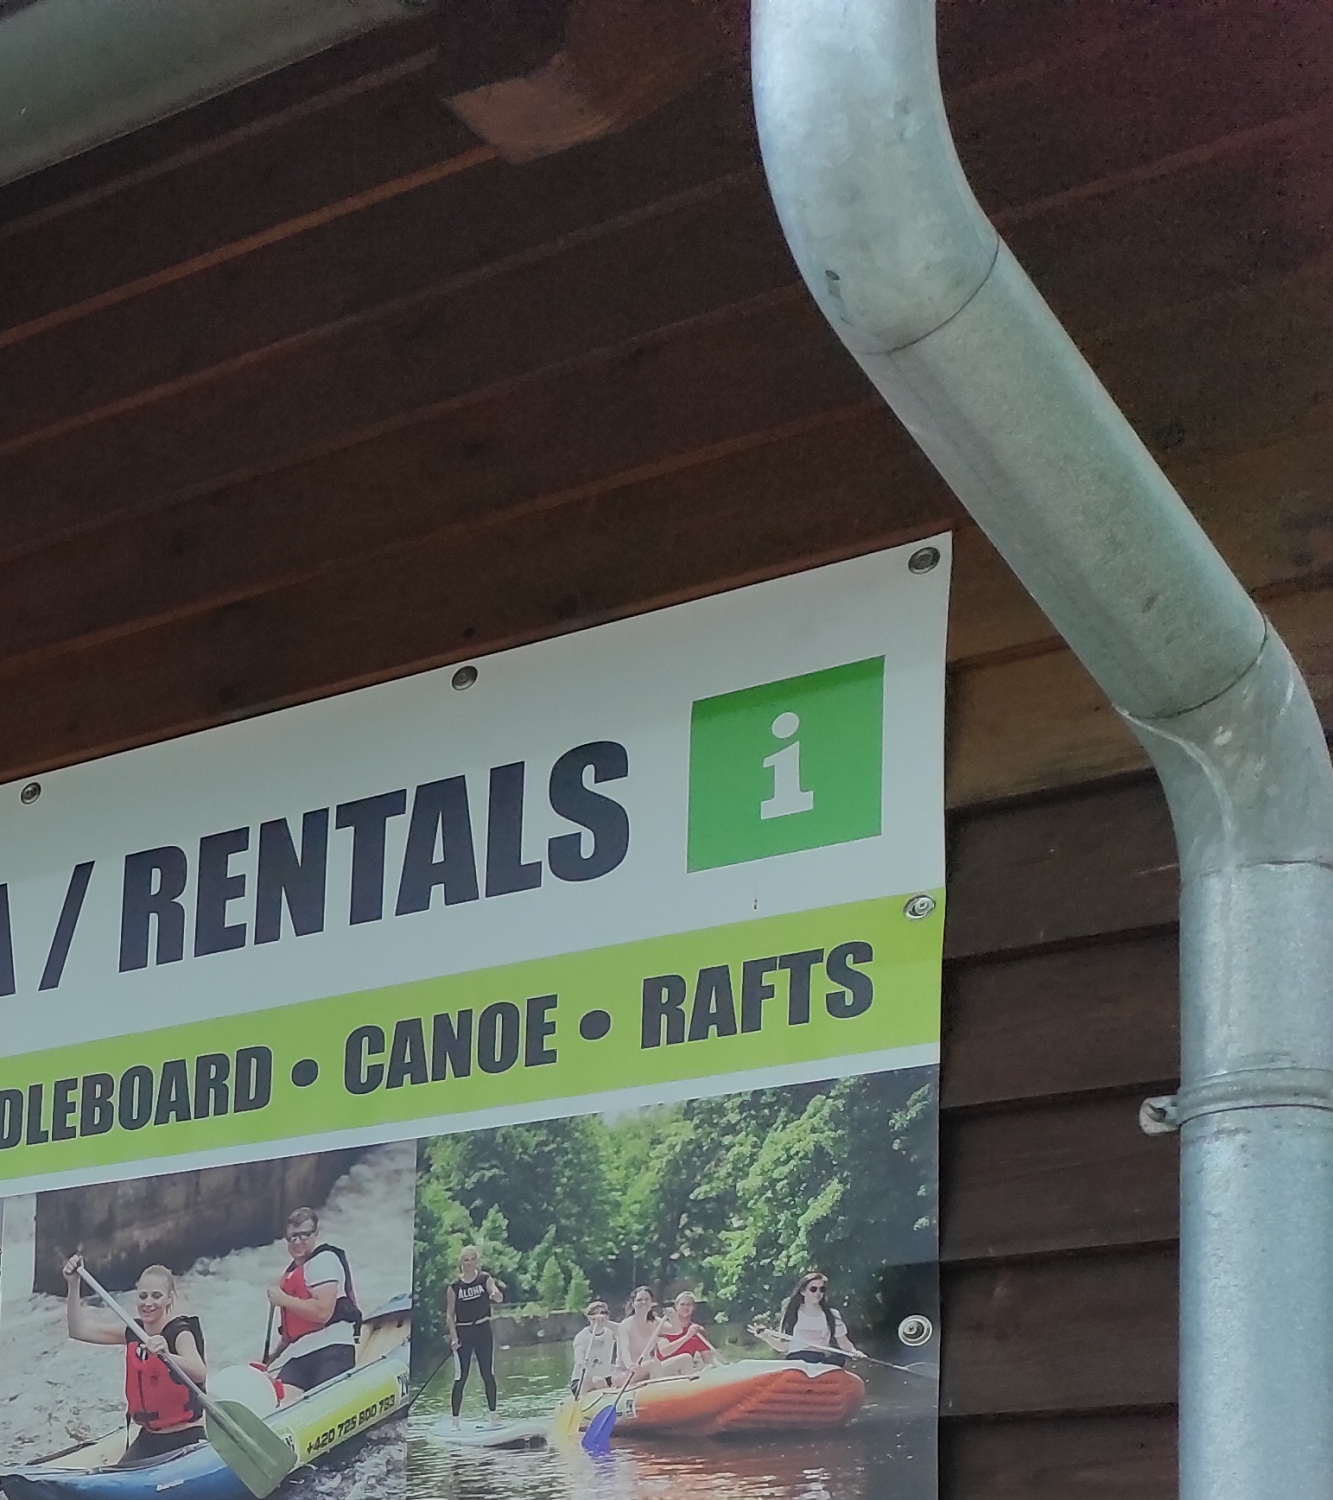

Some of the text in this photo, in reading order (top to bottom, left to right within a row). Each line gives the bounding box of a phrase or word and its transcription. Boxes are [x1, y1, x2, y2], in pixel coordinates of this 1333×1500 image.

[38, 861, 95, 990] /
[118, 741, 630, 973] RENTALS
[344, 995, 558, 1095] CANOE
[640, 941, 874, 1050] RAFTS
[458, 1284, 485, 1300] ALOHA
